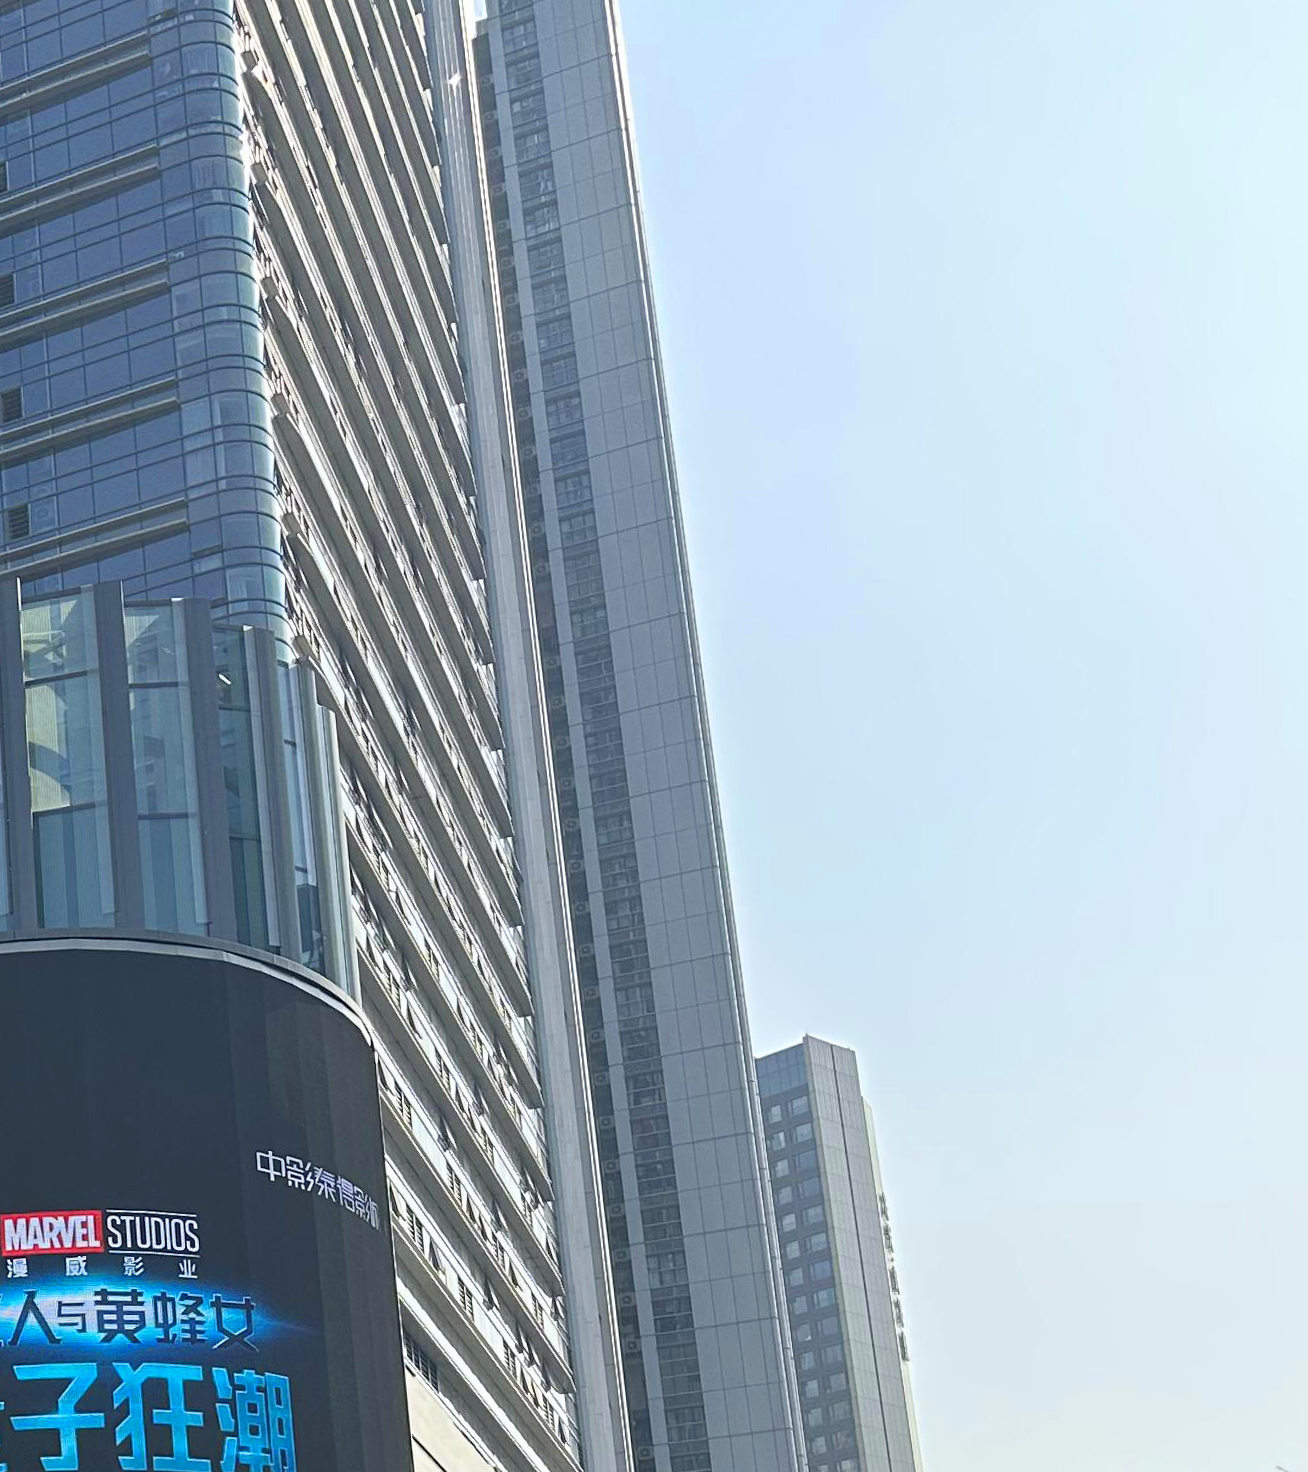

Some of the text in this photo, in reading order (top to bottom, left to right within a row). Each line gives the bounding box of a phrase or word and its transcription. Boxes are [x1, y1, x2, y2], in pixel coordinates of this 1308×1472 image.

[3, 1214, 200, 1253] MARVEL STUDIOS
[7, 1256, 198, 1279] 漫威影业
